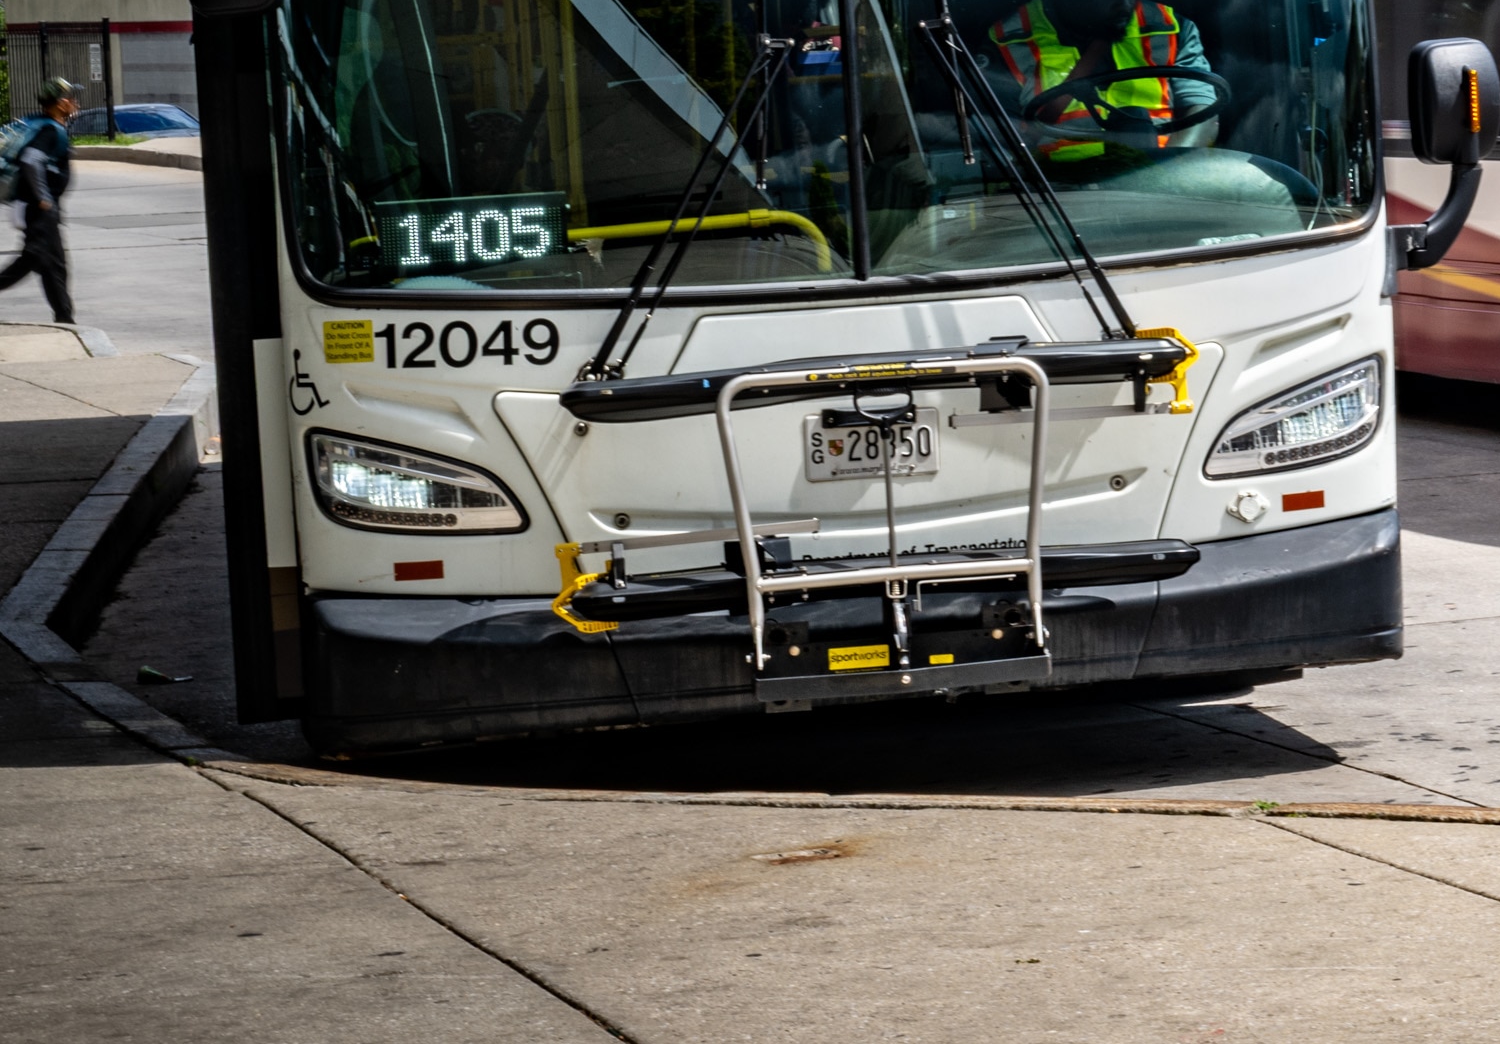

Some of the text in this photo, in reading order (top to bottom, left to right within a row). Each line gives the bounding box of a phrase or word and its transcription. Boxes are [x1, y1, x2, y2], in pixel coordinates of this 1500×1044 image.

[399, 207, 550, 266] 1405
[331, 322, 365, 330] CAUTION
[374, 318, 560, 369] 12049
